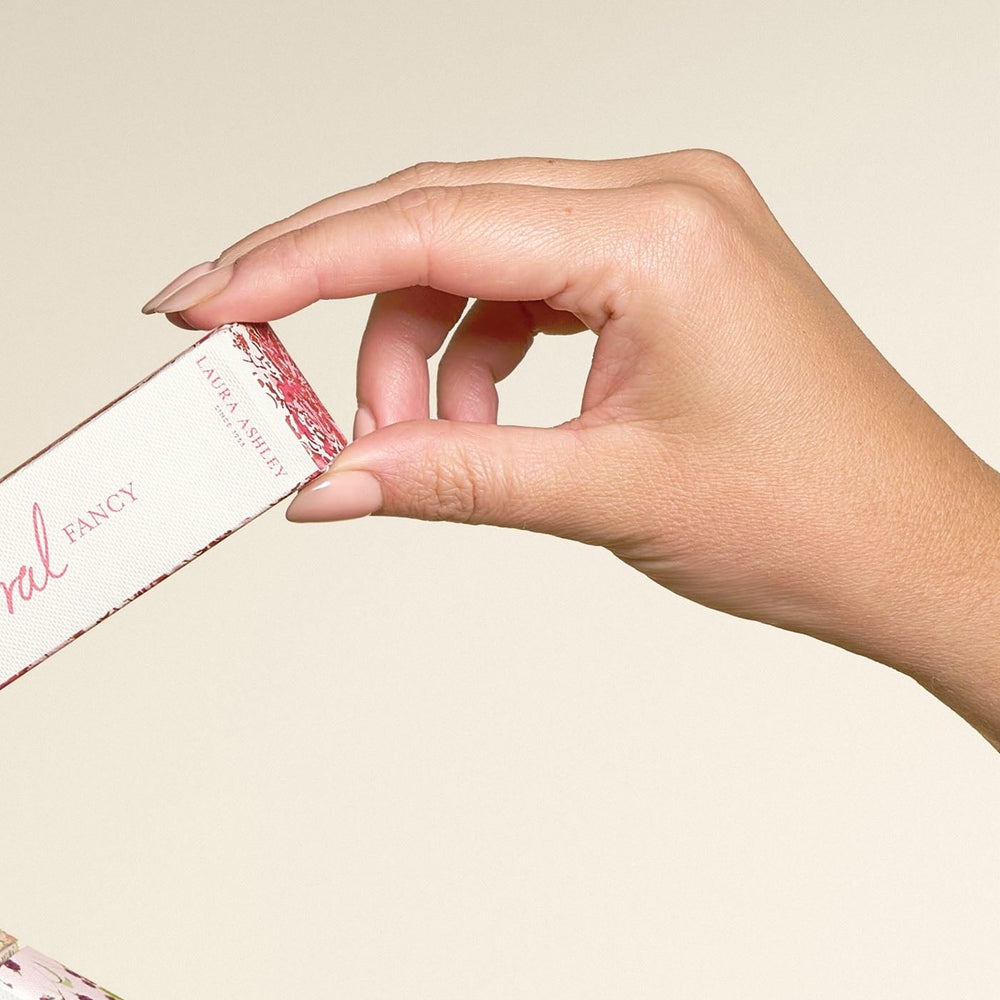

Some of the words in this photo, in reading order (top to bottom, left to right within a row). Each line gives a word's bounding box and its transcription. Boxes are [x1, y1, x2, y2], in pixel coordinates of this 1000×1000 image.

[196, 355, 238, 414] LAURA
[237, 418, 289, 479] ASHLEY
[62, 482, 138, 544] FANCY
